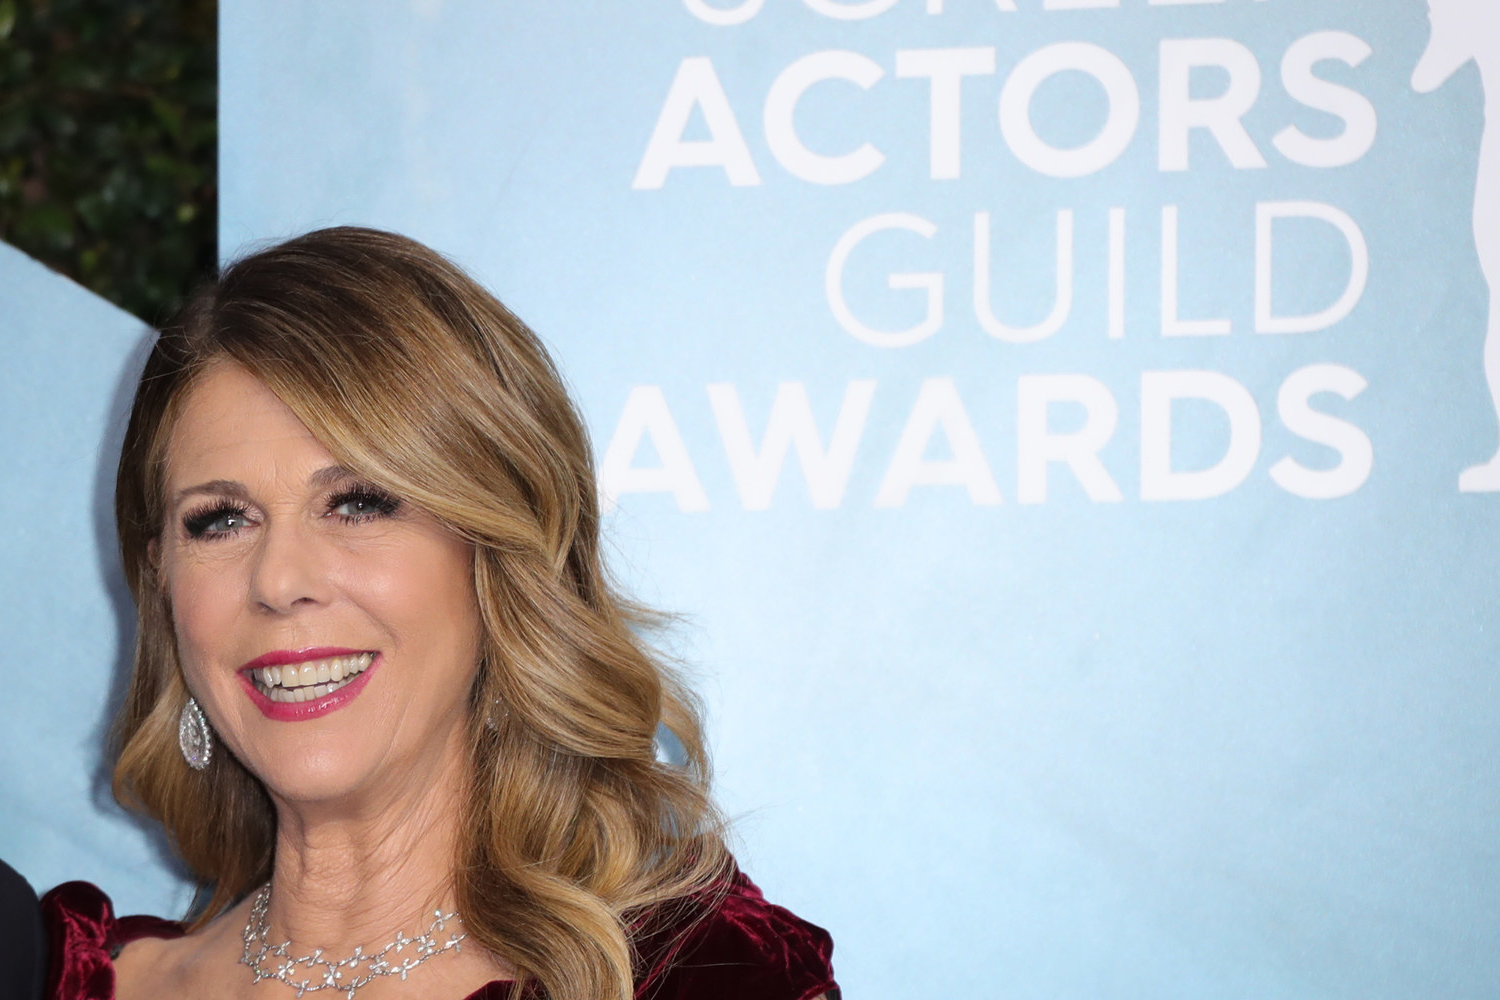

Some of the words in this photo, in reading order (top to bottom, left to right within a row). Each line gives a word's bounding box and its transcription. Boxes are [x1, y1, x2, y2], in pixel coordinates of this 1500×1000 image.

[631, 30, 1378, 190] ACTORS
[824, 200, 1370, 348] GUILD
[597, 363, 1375, 514] AWARDS
